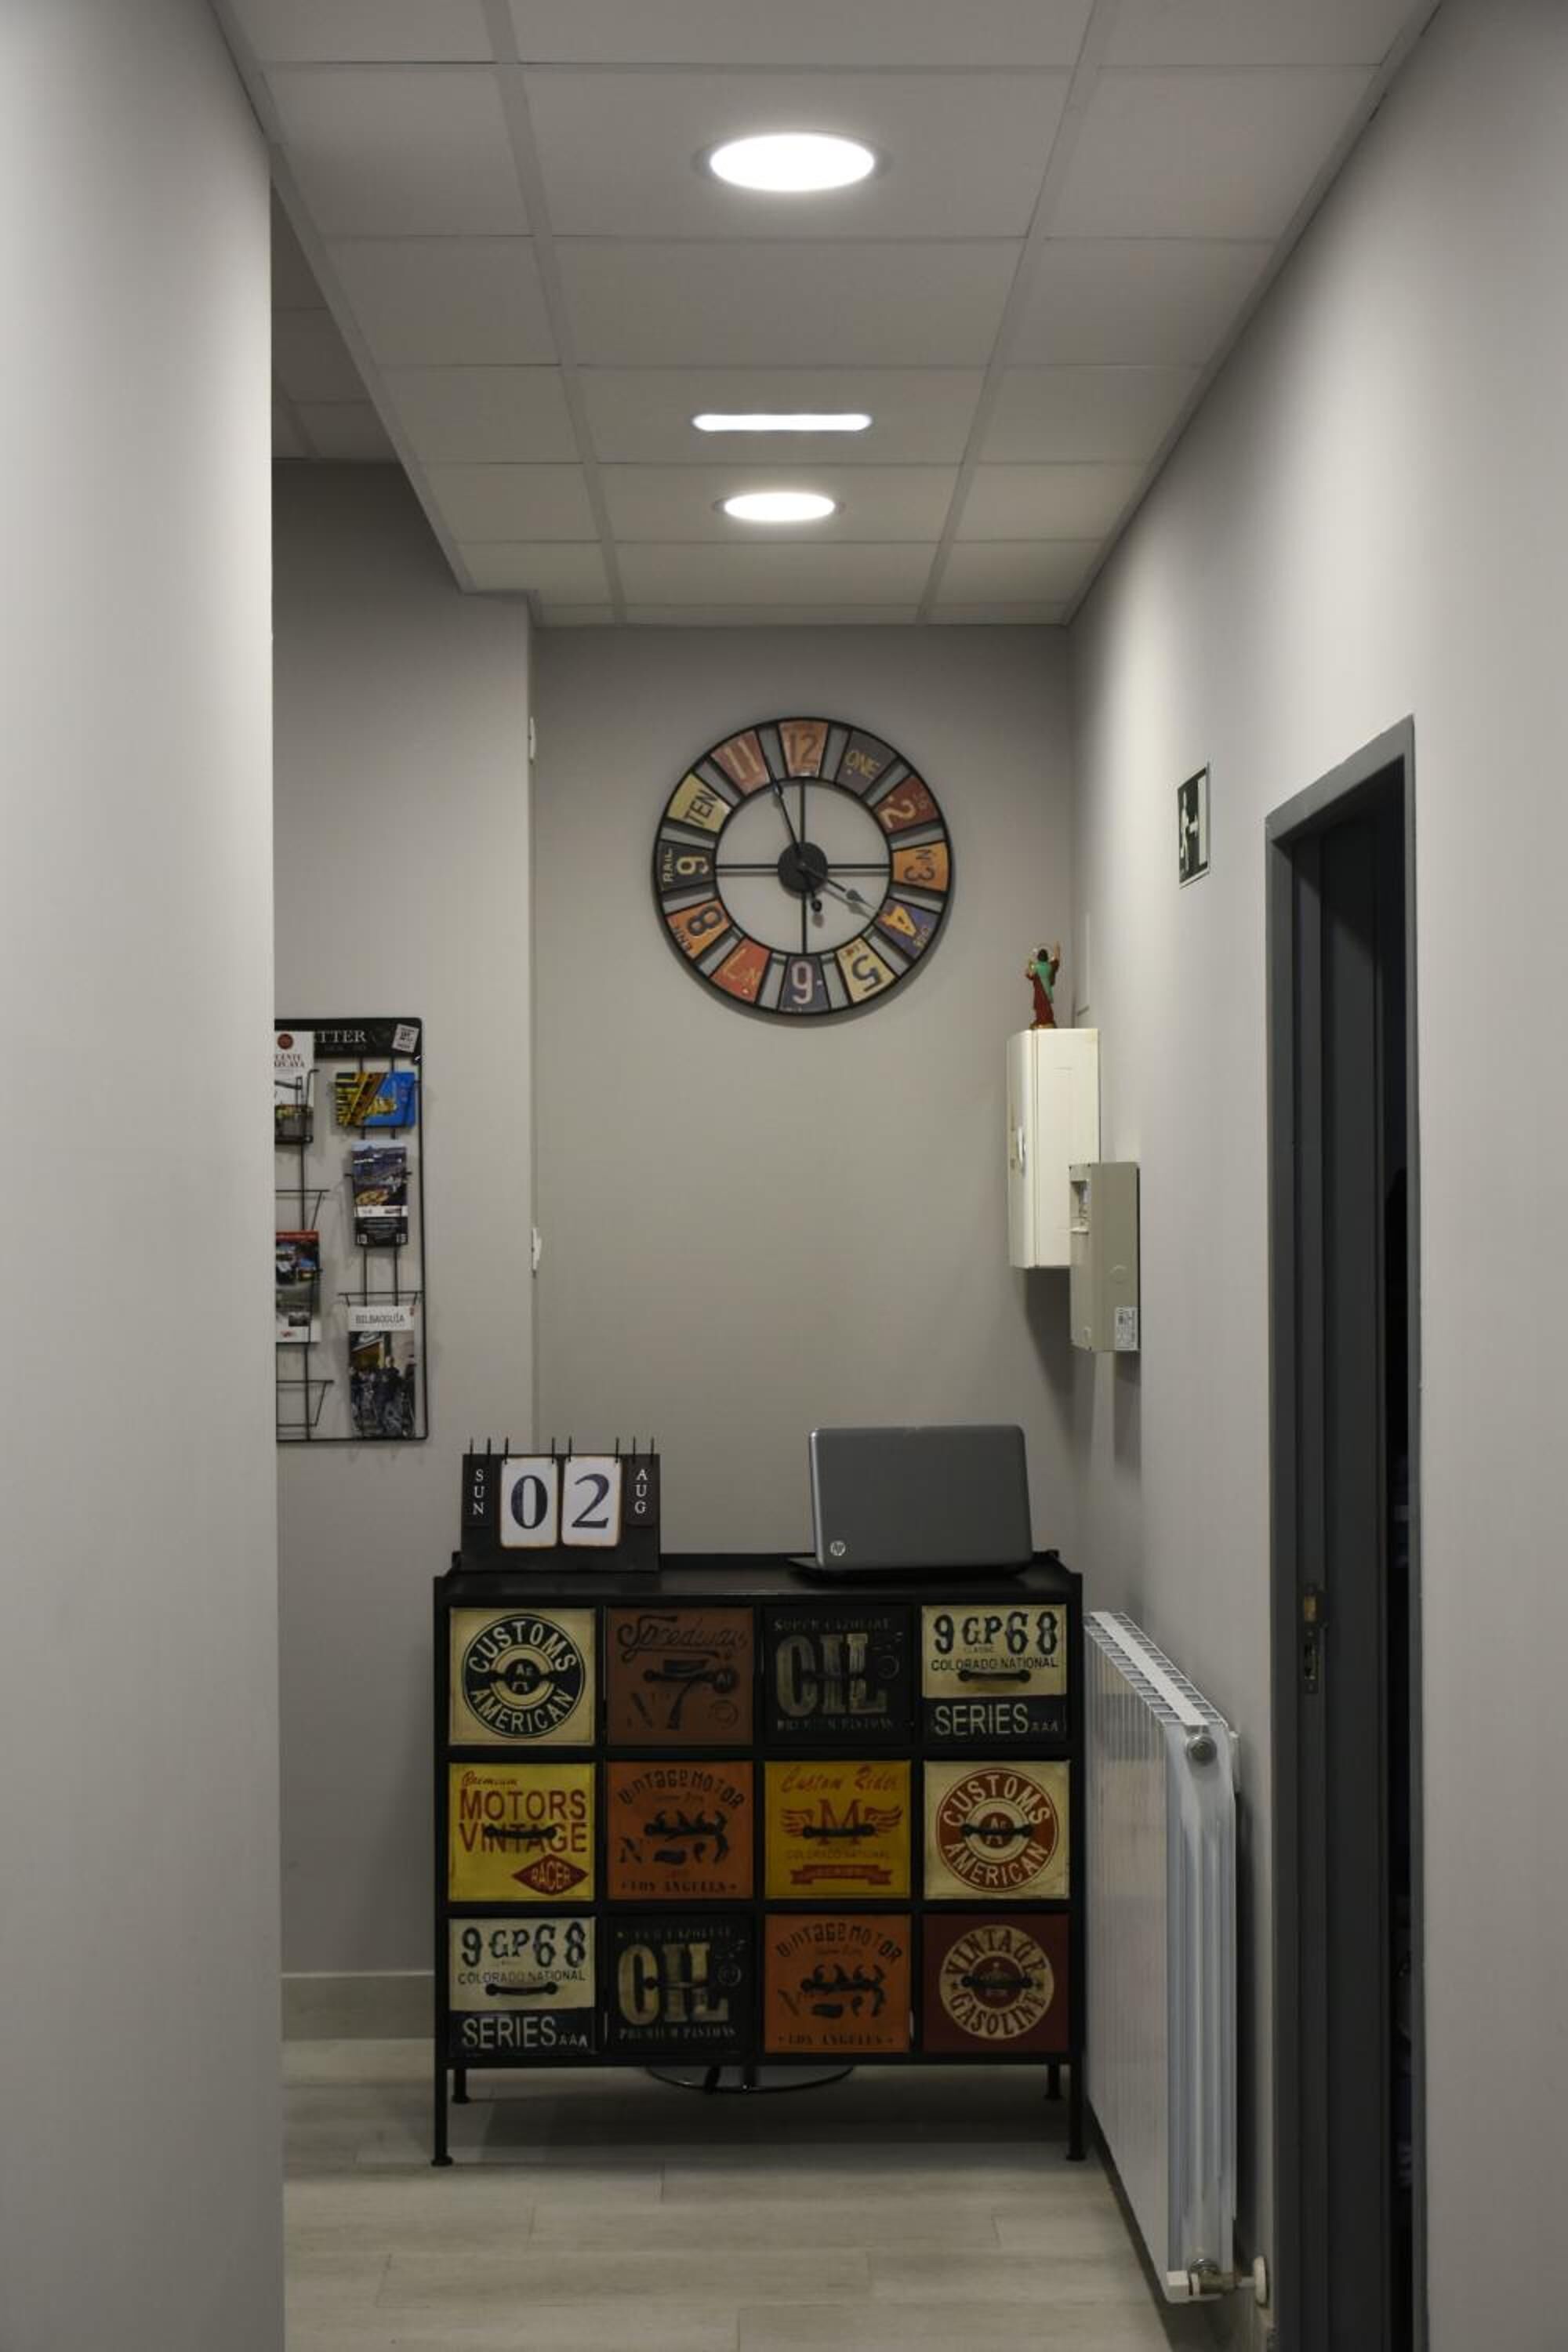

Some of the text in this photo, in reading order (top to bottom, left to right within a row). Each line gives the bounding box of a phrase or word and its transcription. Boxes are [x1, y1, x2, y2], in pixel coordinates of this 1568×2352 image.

[723, 739, 760, 780] 11
[787, 732, 819, 771] 12
[845, 750, 880, 779] ONE
[684, 790, 717, 827] TEN
[878, 795, 916, 829] 2
[677, 855, 707, 876] 9
[686, 905, 723, 937] 8
[851, 952, 881, 993] 5
[472, 1468, 485, 1515] SUN
[633, 1468, 648, 1514] AUG
[468, 1621, 577, 1673] CUSTOMS
[931, 1657, 1058, 1671] COLORADO NATIONAL
[471, 1688, 575, 1733] AMERICAN
[935, 1703, 1029, 1736] SERIES
[459, 1788, 586, 1821] MOTORS
[943, 1774, 1051, 1828] CUSTOMS
[459, 1822, 586, 1853] VINTAGE
[818, 1798, 862, 1845] M
[531, 1860, 572, 1890] RACER
[944, 1842, 1049, 1886] AMERICAN
[945, 1929, 1047, 1975] VINTAGE
[458, 1969, 586, 1985] COLORADO NATIONAL
[462, 2016, 557, 2049] SERIES
